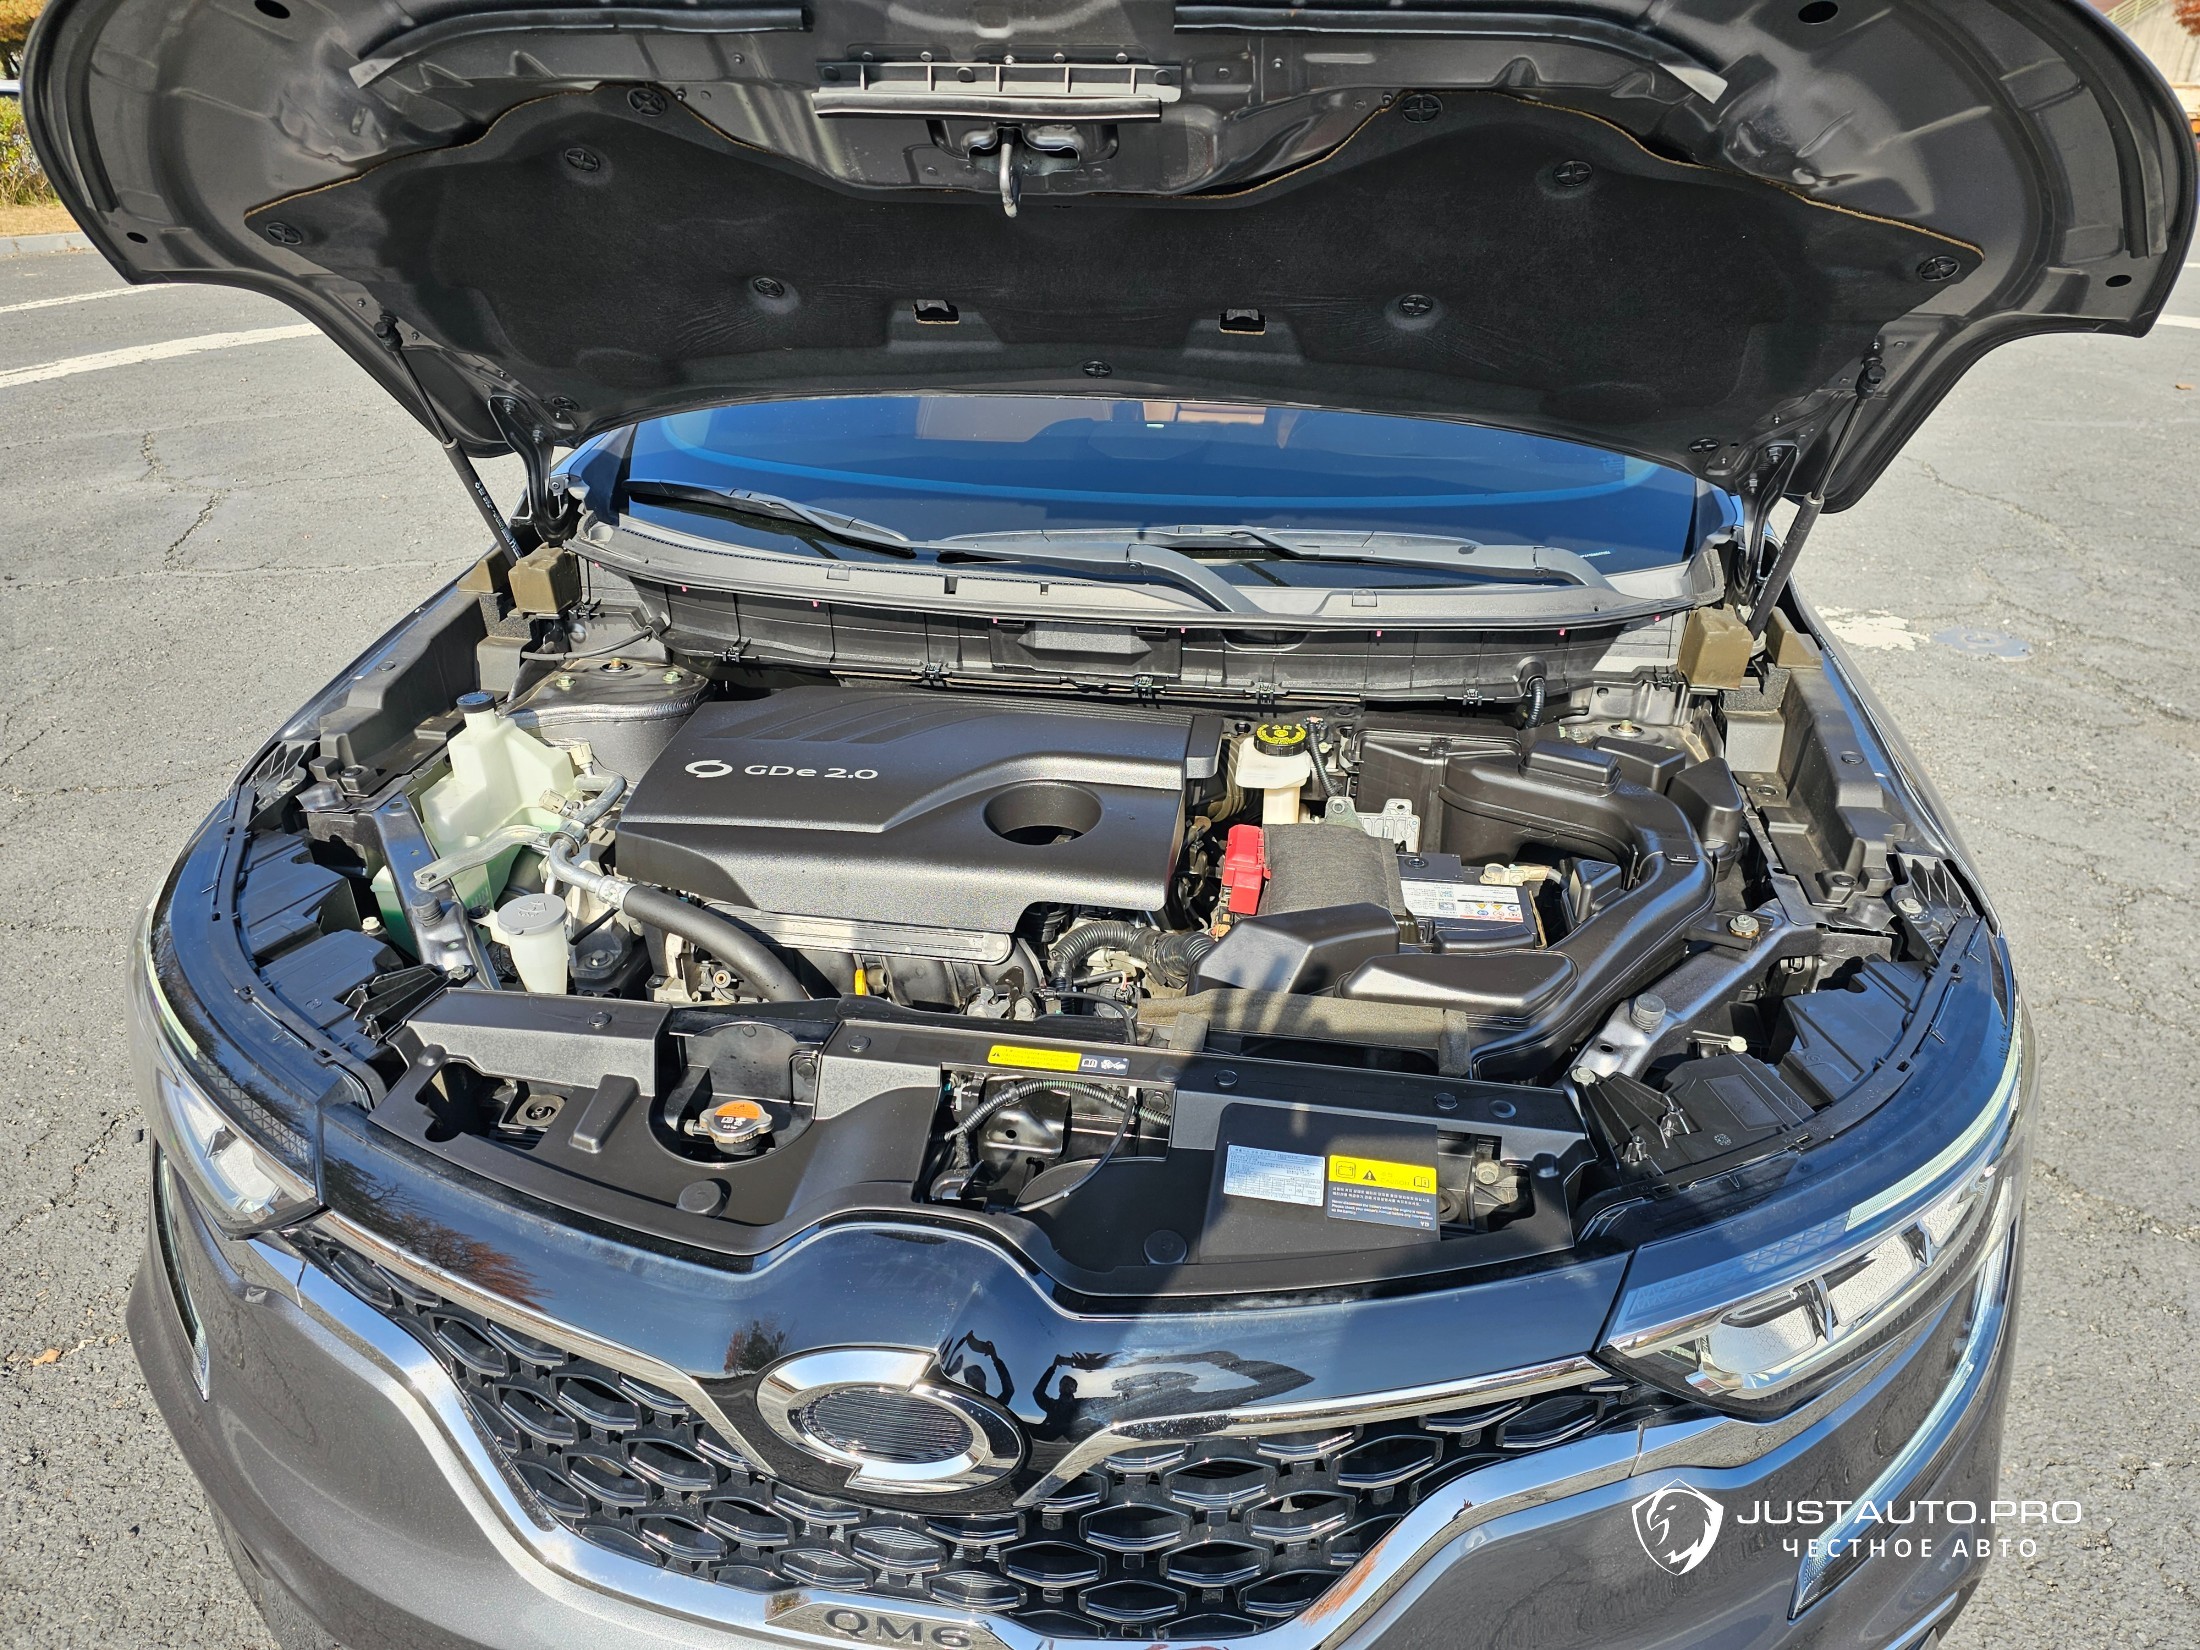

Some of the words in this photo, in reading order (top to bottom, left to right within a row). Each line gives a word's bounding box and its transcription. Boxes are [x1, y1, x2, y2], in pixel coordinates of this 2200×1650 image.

[744, 765, 817, 777] GDe
[824, 768, 878, 780] 2.0
[824, 1608, 972, 1649] QM6
